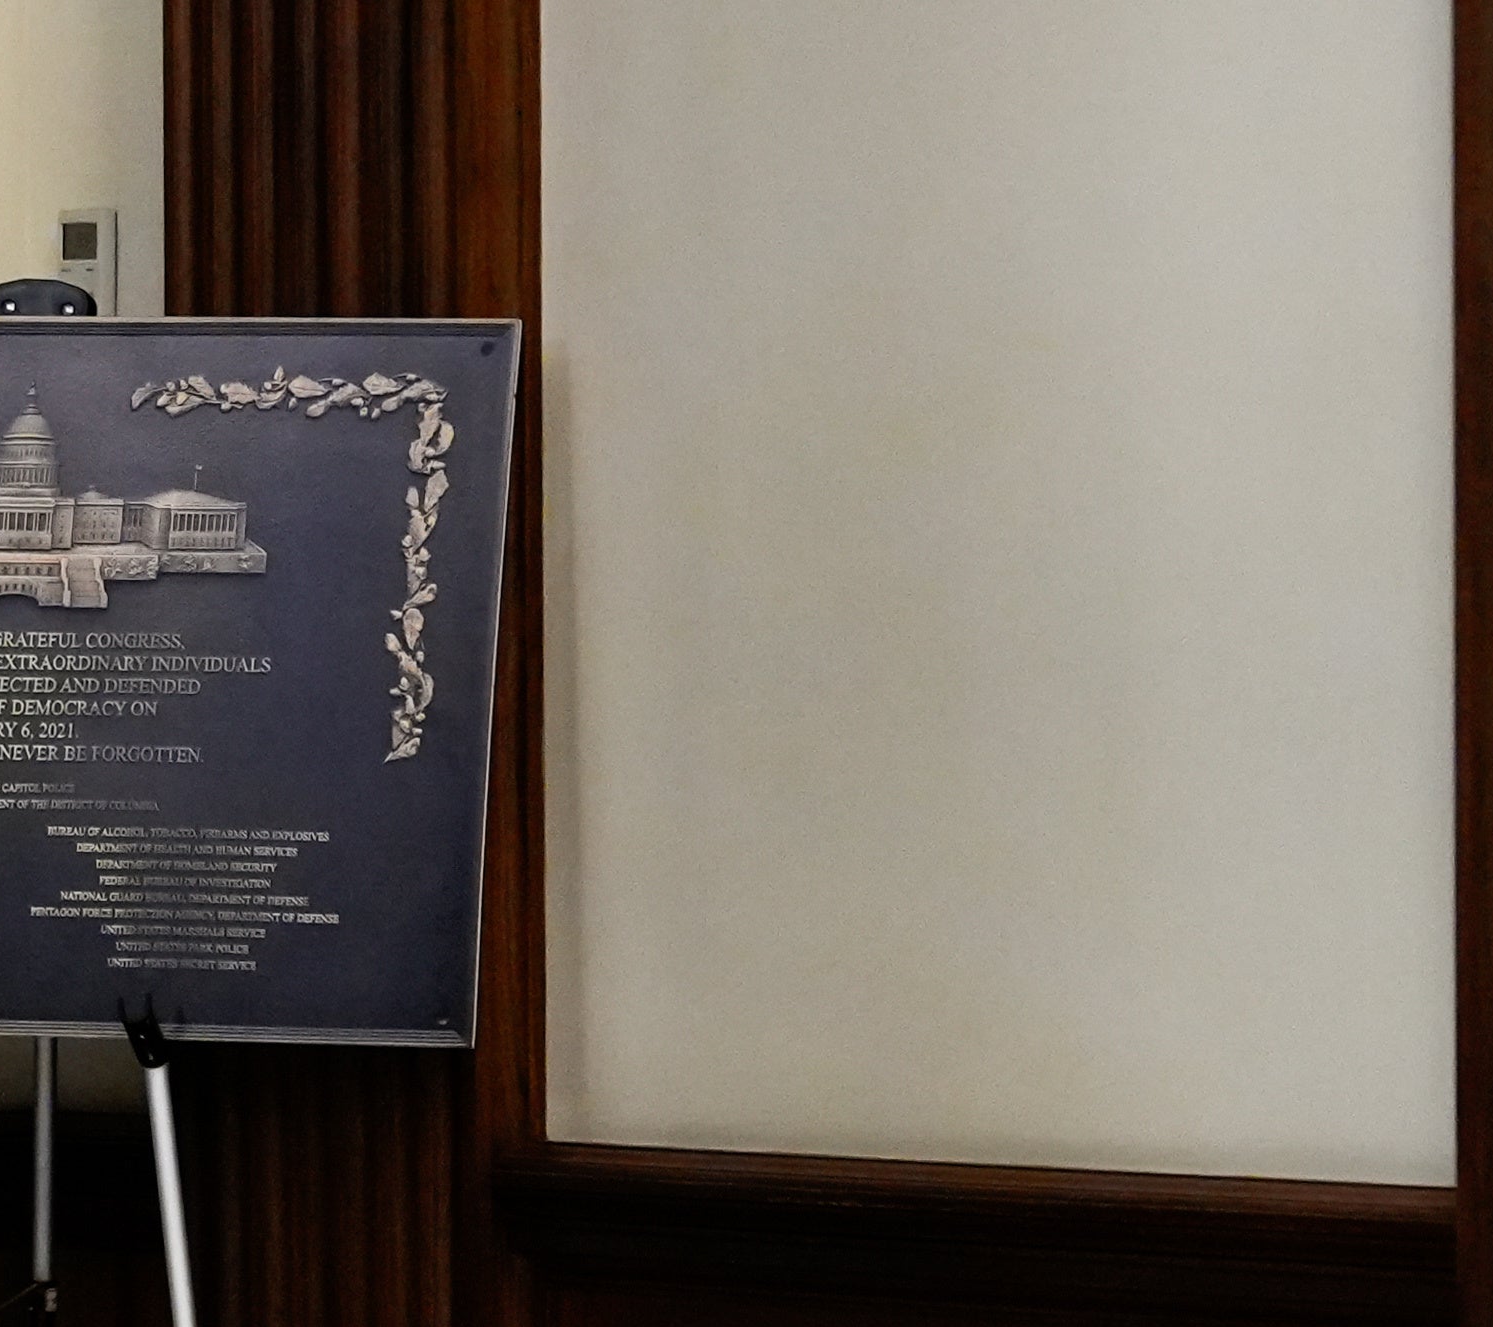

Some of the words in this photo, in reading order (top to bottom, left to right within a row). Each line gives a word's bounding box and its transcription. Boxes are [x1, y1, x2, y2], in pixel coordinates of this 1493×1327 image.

[86, 632, 185, 650] CONGRESS,
[151, 656, 272, 673] INDIVIDUALS
[59, 677, 101, 693] AND
[104, 678, 201, 694] DEFENDED
[11, 699, 127, 716] DEMOCRACY
[130, 700, 157, 716] ON
[21, 723, 34, 739] 6,
[0, 744, 58, 761] NEVER
[64, 745, 86, 762] BE
[92, 746, 204, 763] FORGOTTEN.
[16, 799, 30, 809] OF
[60, 891, 108, 902] NATIONAL
[31, 906, 81, 917] PENTAGON
